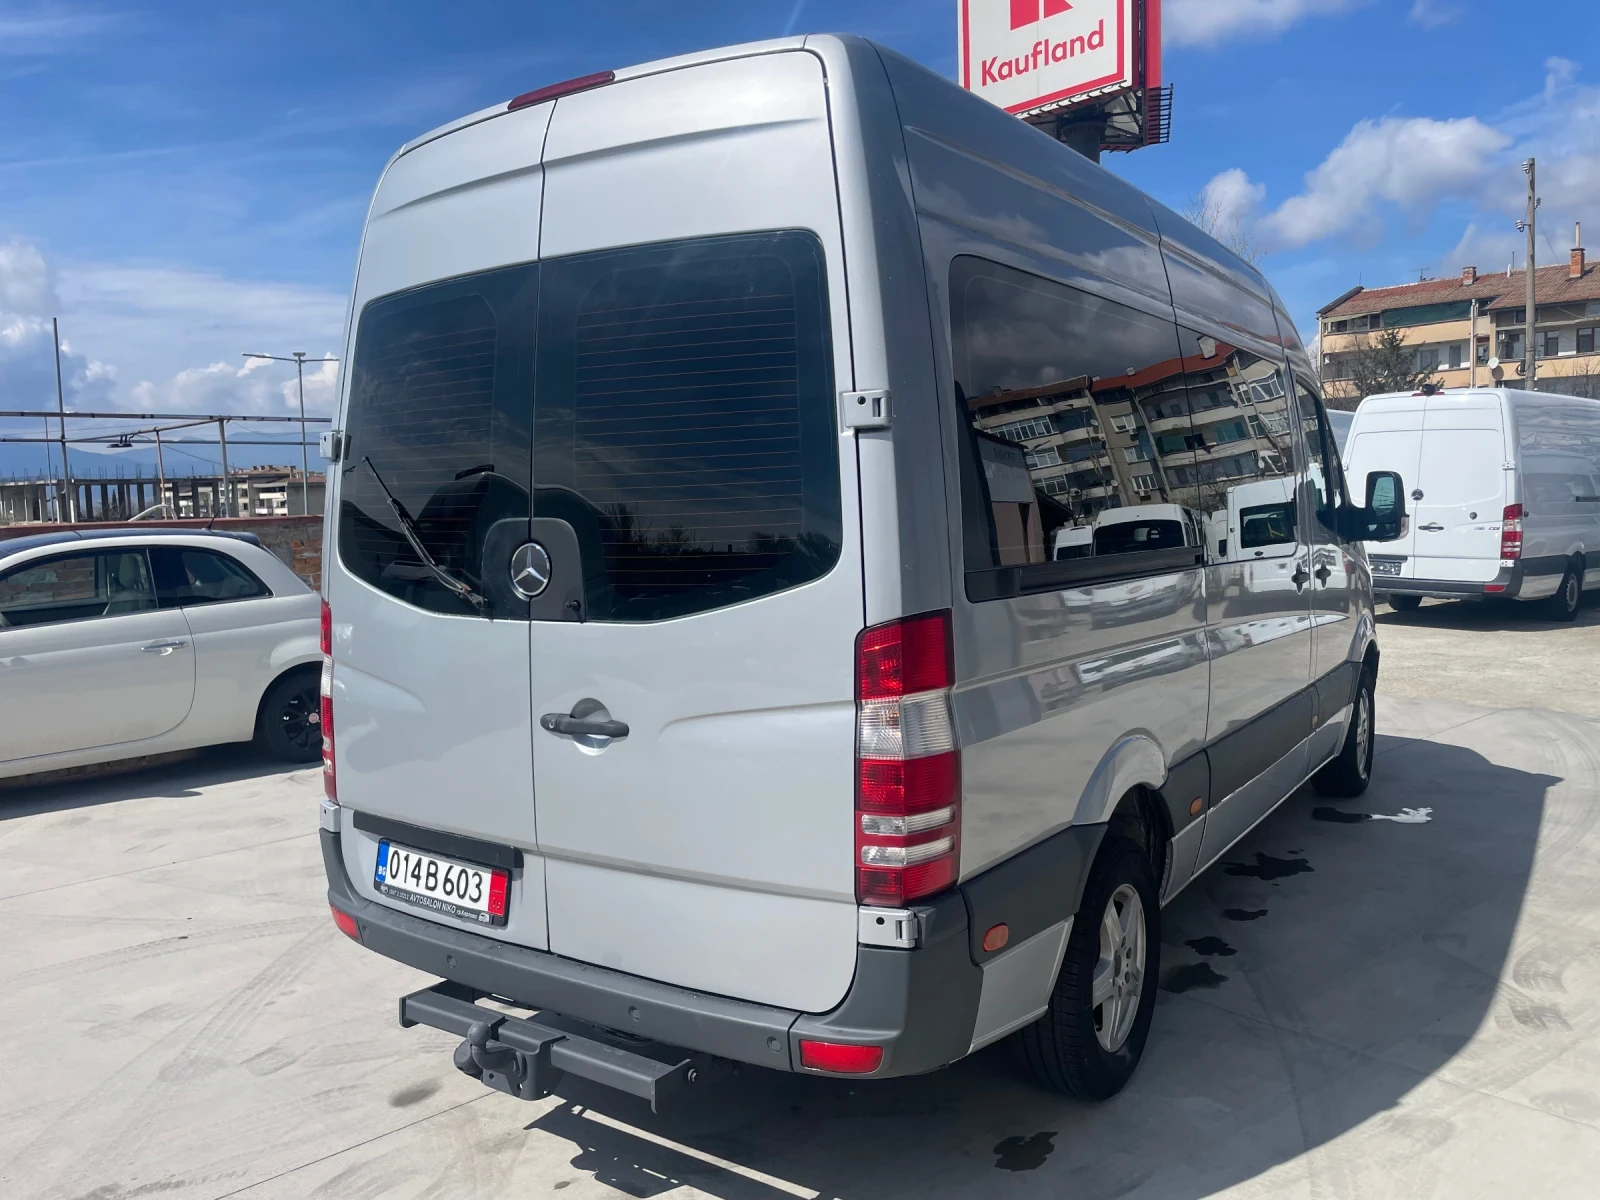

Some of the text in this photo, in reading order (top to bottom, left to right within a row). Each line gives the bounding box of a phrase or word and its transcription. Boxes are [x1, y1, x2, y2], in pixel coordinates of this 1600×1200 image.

[981, 19, 1104, 87] Kaufland
[378, 865, 387, 876] BG
[409, 893, 442, 910] AVTOSALON
[441, 902, 456, 914] NIKO
